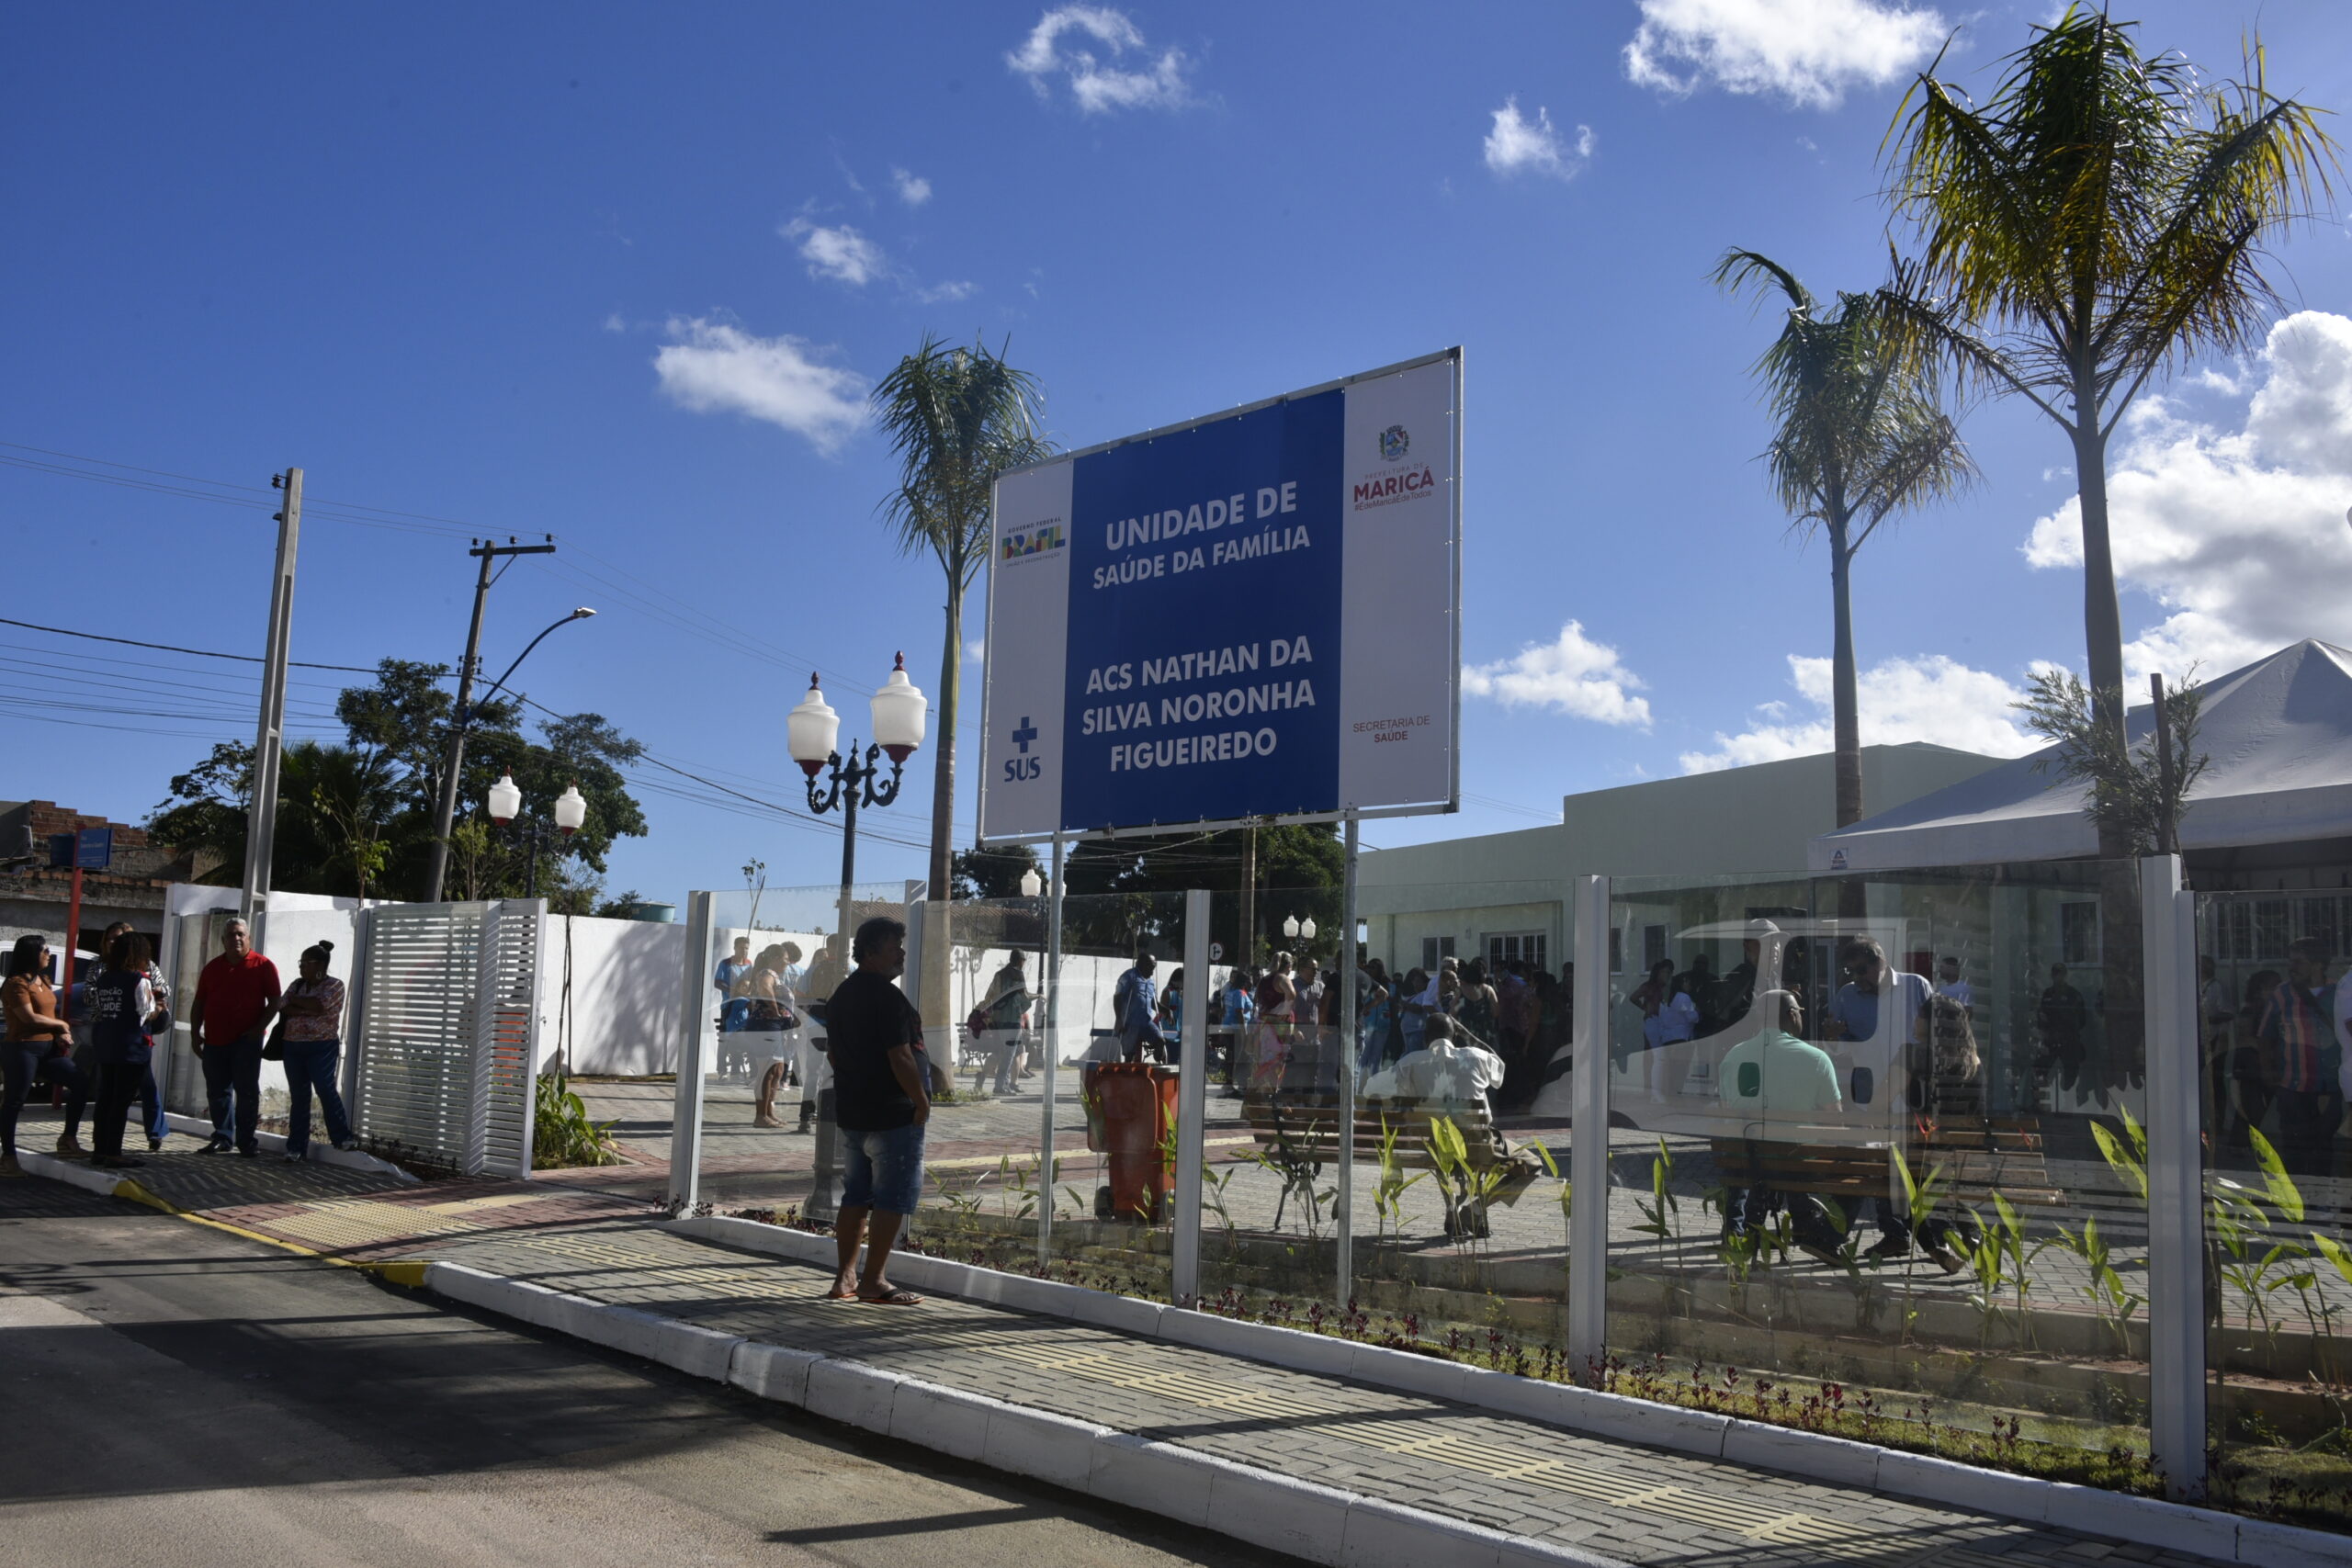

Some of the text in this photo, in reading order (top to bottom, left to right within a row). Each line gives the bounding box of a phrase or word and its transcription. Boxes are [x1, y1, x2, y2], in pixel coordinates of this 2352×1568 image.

[1353, 466, 1434, 502] MARICÁ
[1106, 480, 1297, 551] UNIDADE DE
[1001, 525, 1066, 560] BRASIL
[1093, 525, 1311, 589] SAÚDE DA FAMÍLIA
[1085, 636, 1313, 694] ACS NATHAN DA
[1082, 679, 1316, 735] SILVA NORONHA
[1352, 715, 1430, 733] SECRETARIA DE
[1004, 756, 1041, 783] SUS
[1111, 728, 1277, 773] FIGUEIREDO
